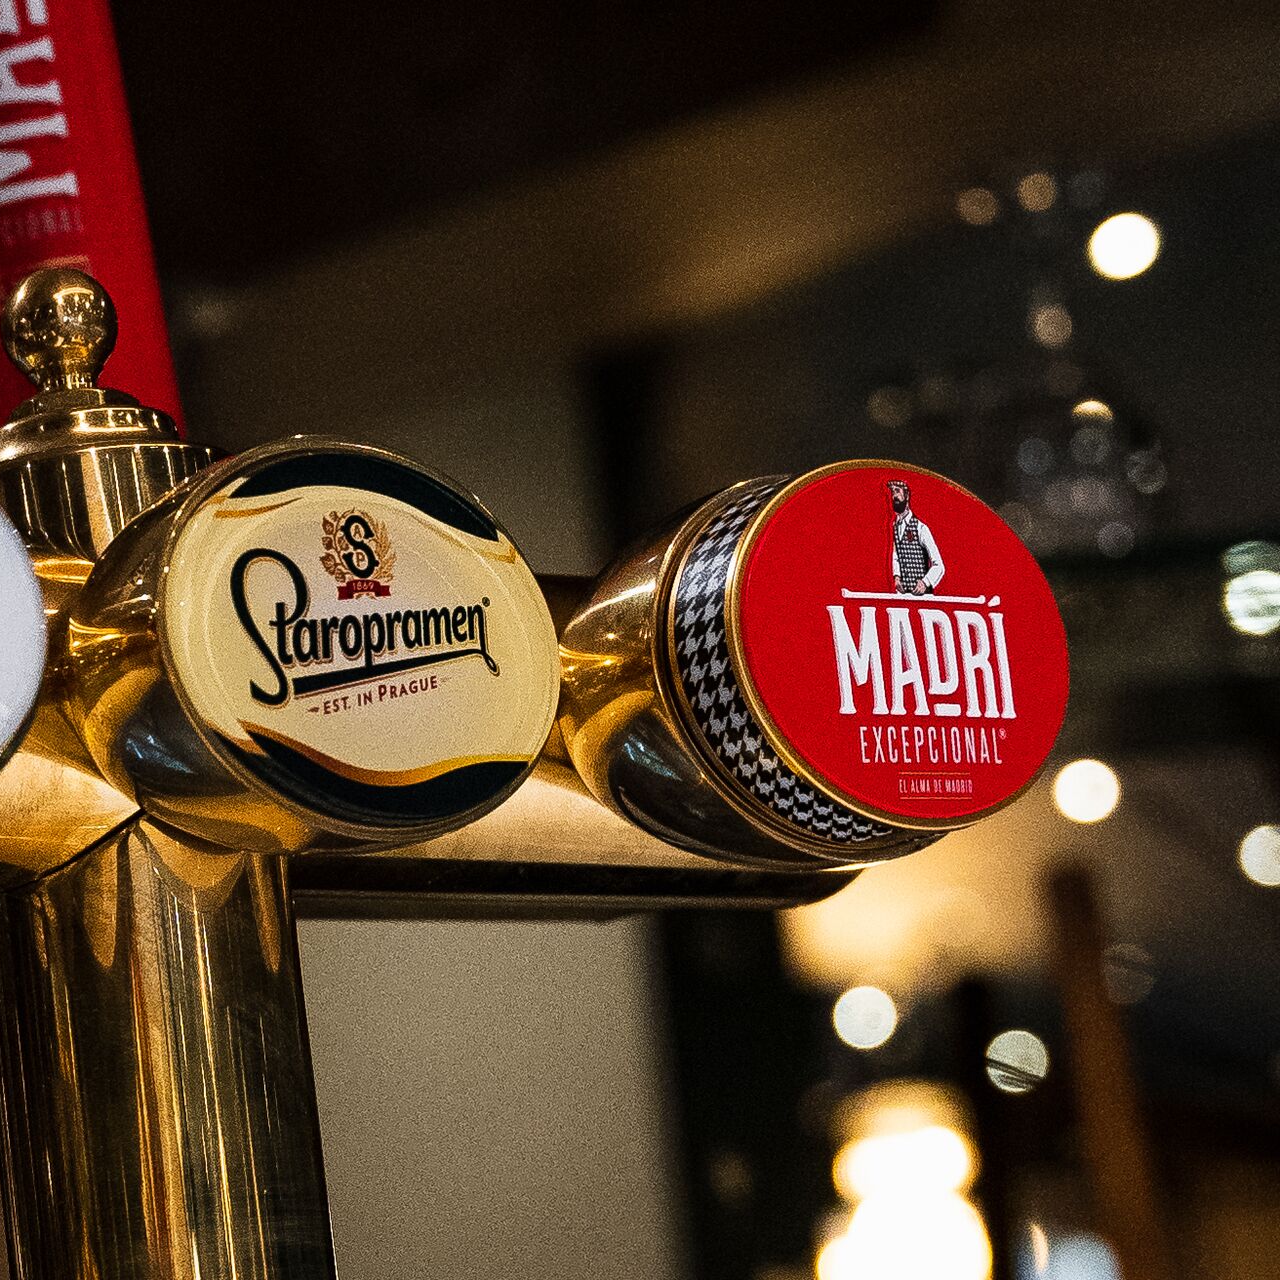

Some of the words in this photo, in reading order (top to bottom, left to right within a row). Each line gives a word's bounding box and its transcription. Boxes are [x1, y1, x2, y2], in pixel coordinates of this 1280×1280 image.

[230, 547, 500, 706] Staropramen
[825, 595, 1017, 720] MADRÍ
[322, 695, 351, 715] EST.
[357, 690, 373, 707] IN
[377, 675, 439, 702] PRAGUE
[858, 725, 1003, 765] EXCEPCIONAL
[898, 779, 908, 794] EL
[910, 779, 931, 794] ALMA
[933, 779, 943, 794] DE
[944, 779, 973, 795] MADRID
